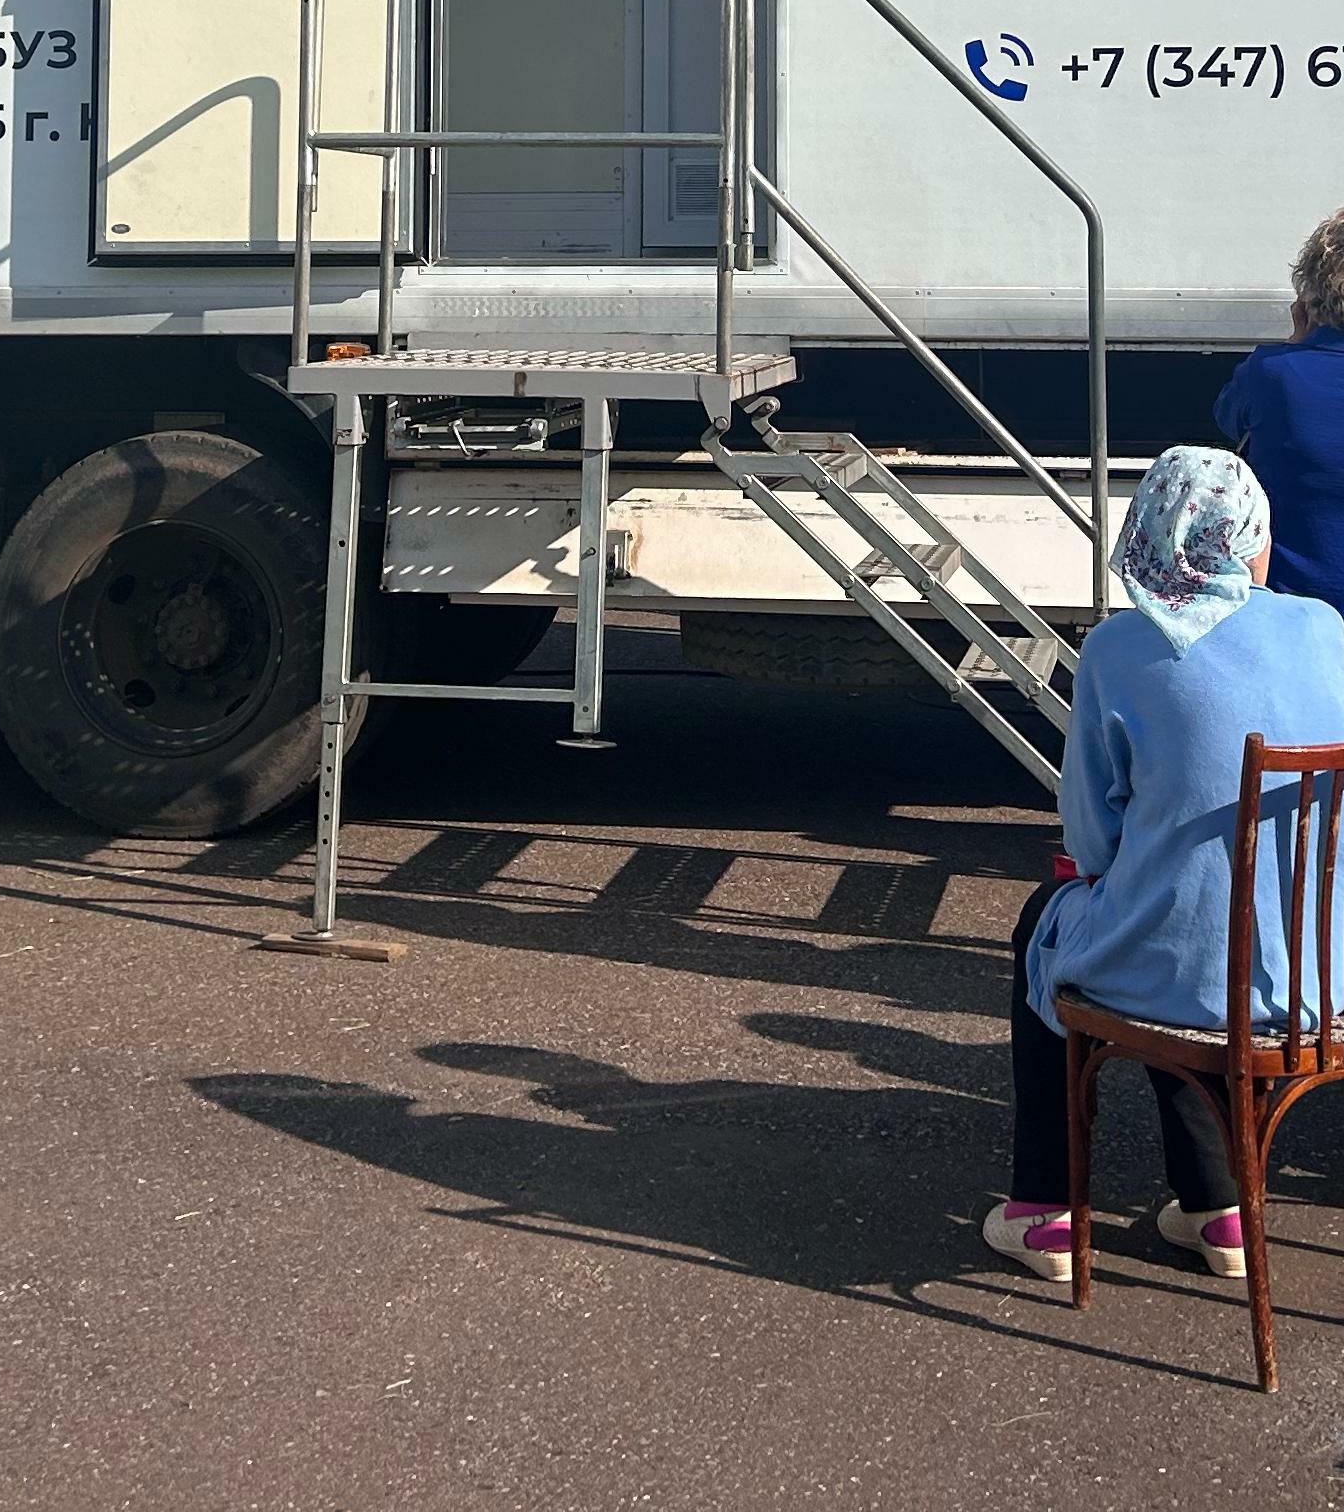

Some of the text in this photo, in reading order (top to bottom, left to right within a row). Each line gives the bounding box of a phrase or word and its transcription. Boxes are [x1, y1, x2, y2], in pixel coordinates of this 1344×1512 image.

[1060, 46, 1125, 89] +7
[1146, 44, 1285, 99] (347)
[24, 111, 60, 142] г.
